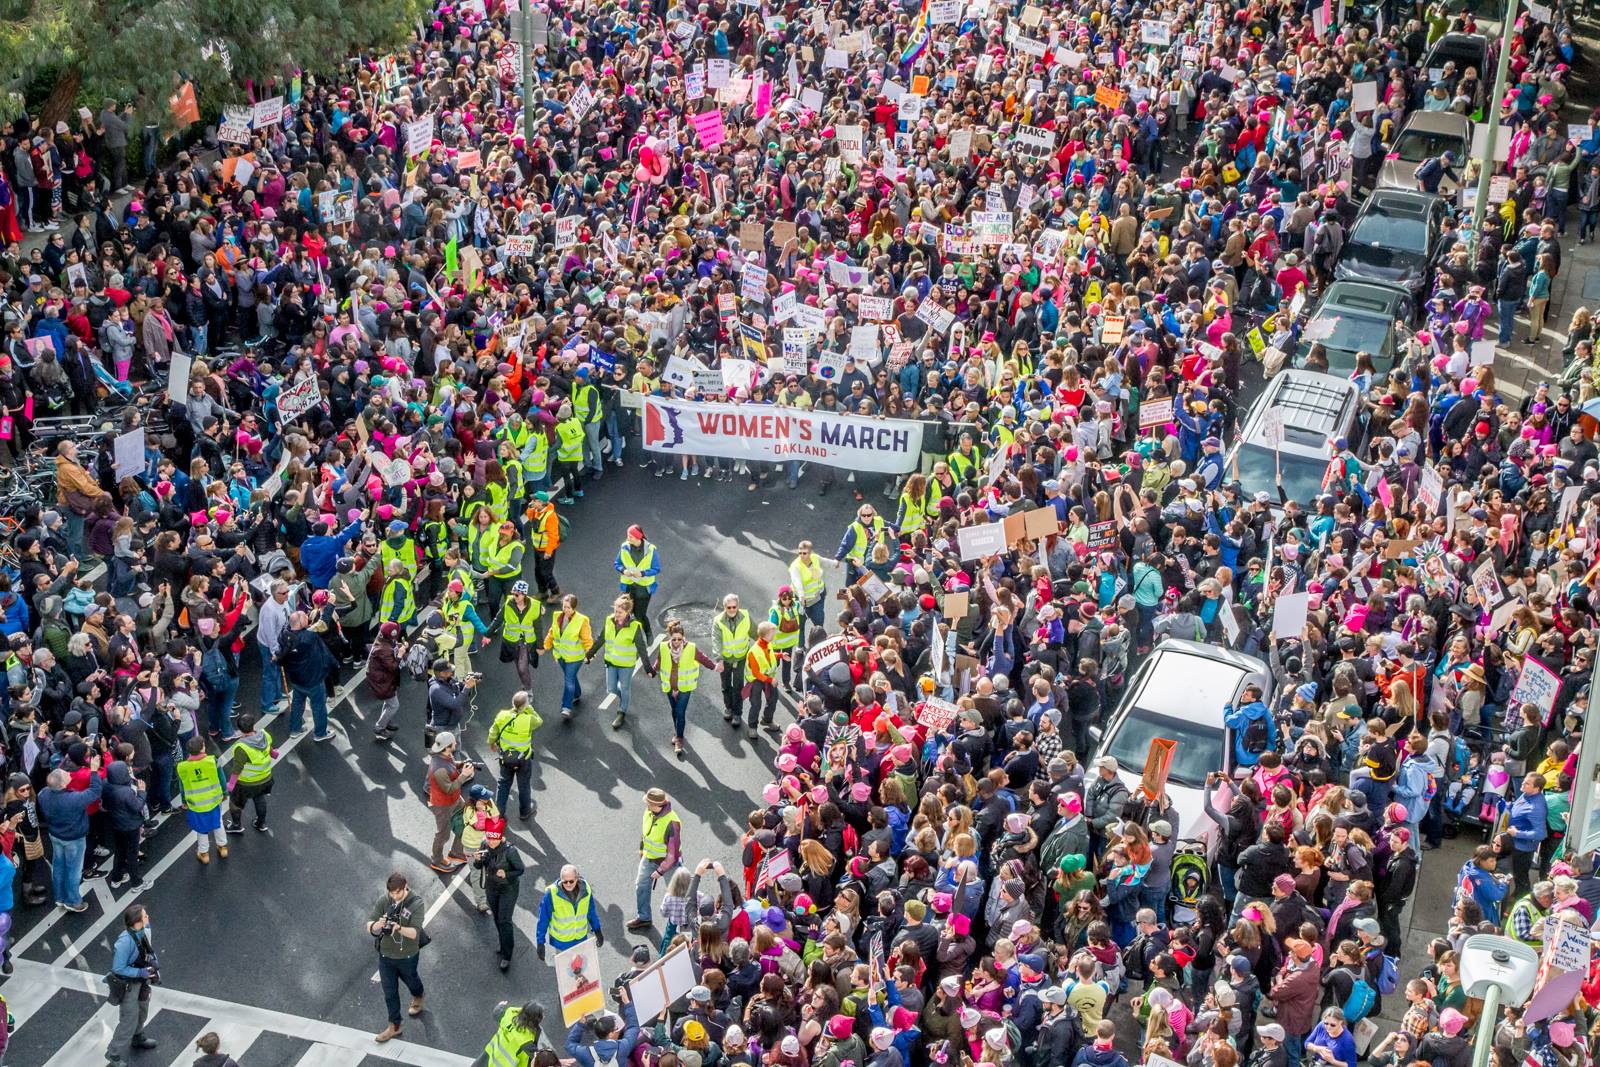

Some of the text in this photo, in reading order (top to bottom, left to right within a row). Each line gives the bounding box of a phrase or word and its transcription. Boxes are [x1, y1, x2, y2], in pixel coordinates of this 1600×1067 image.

[219, 126, 250, 144] RIGHTS
[1019, 125, 1047, 138] MAKE
[996, 213, 1009, 221] ARE
[508, 243, 531, 251] RESIST
[925, 298, 944, 312] HATE
[282, 413, 292, 422] BE
[697, 411, 909, 453] WOMEN'S MARCH
[774, 443, 827, 458] OAKLAND
[1090, 523, 1112, 533] SILENCE
[1090, 529, 1115, 540] WILL NOT
[1088, 538, 1109, 548] PROTECT
